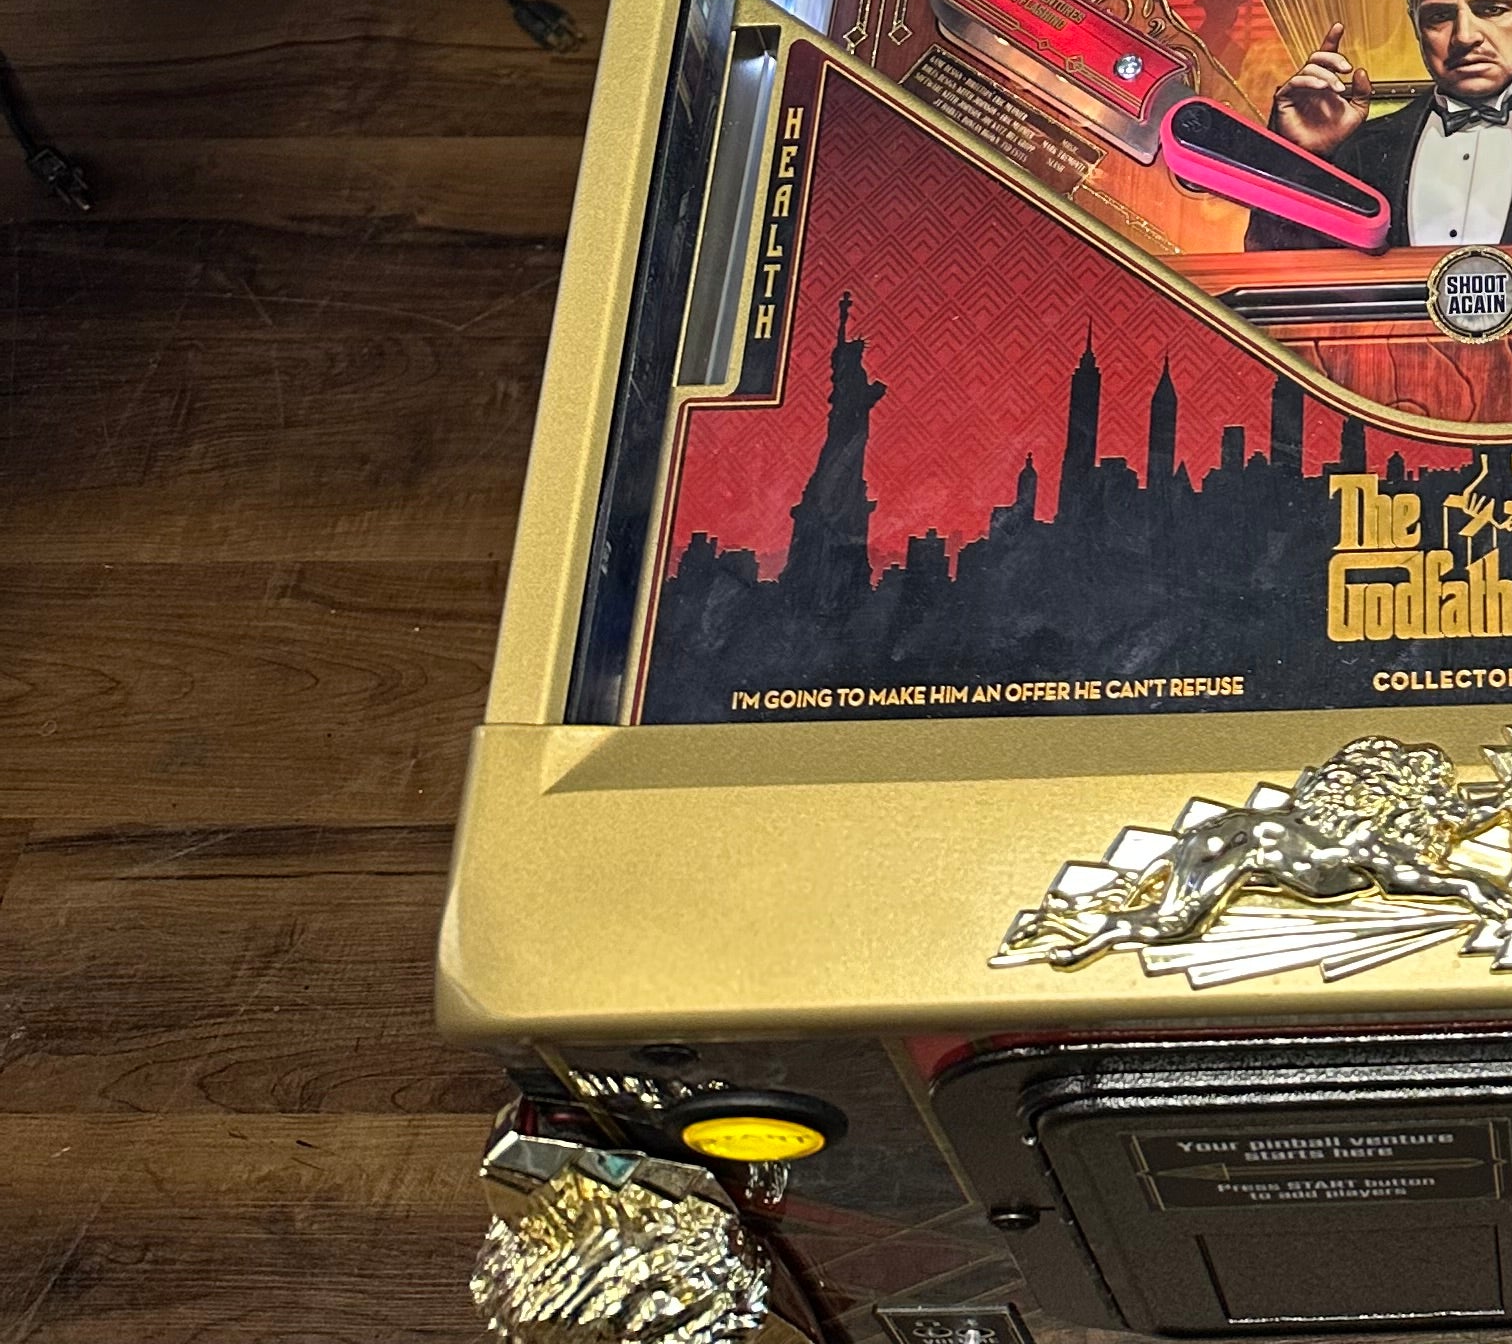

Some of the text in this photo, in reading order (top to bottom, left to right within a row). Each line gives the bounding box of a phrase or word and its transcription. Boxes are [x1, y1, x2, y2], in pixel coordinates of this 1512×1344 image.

[754, 107, 804, 339] HEALTH
[1445, 273, 1508, 297] SHOOT
[1446, 293, 1507, 318] AGAIN
[1329, 473, 1422, 551] The
[732, 675, 1245, 711] I'M GOING TO MAKE HIM AN OFFER HE CAN'T REFUSE
[1177, 1132, 1455, 1154] Your pinball venture
[1244, 1147, 1393, 1162] starts here
[1217, 1176, 1435, 1193] Press START button
[1250, 1187, 1407, 1201] to add players
